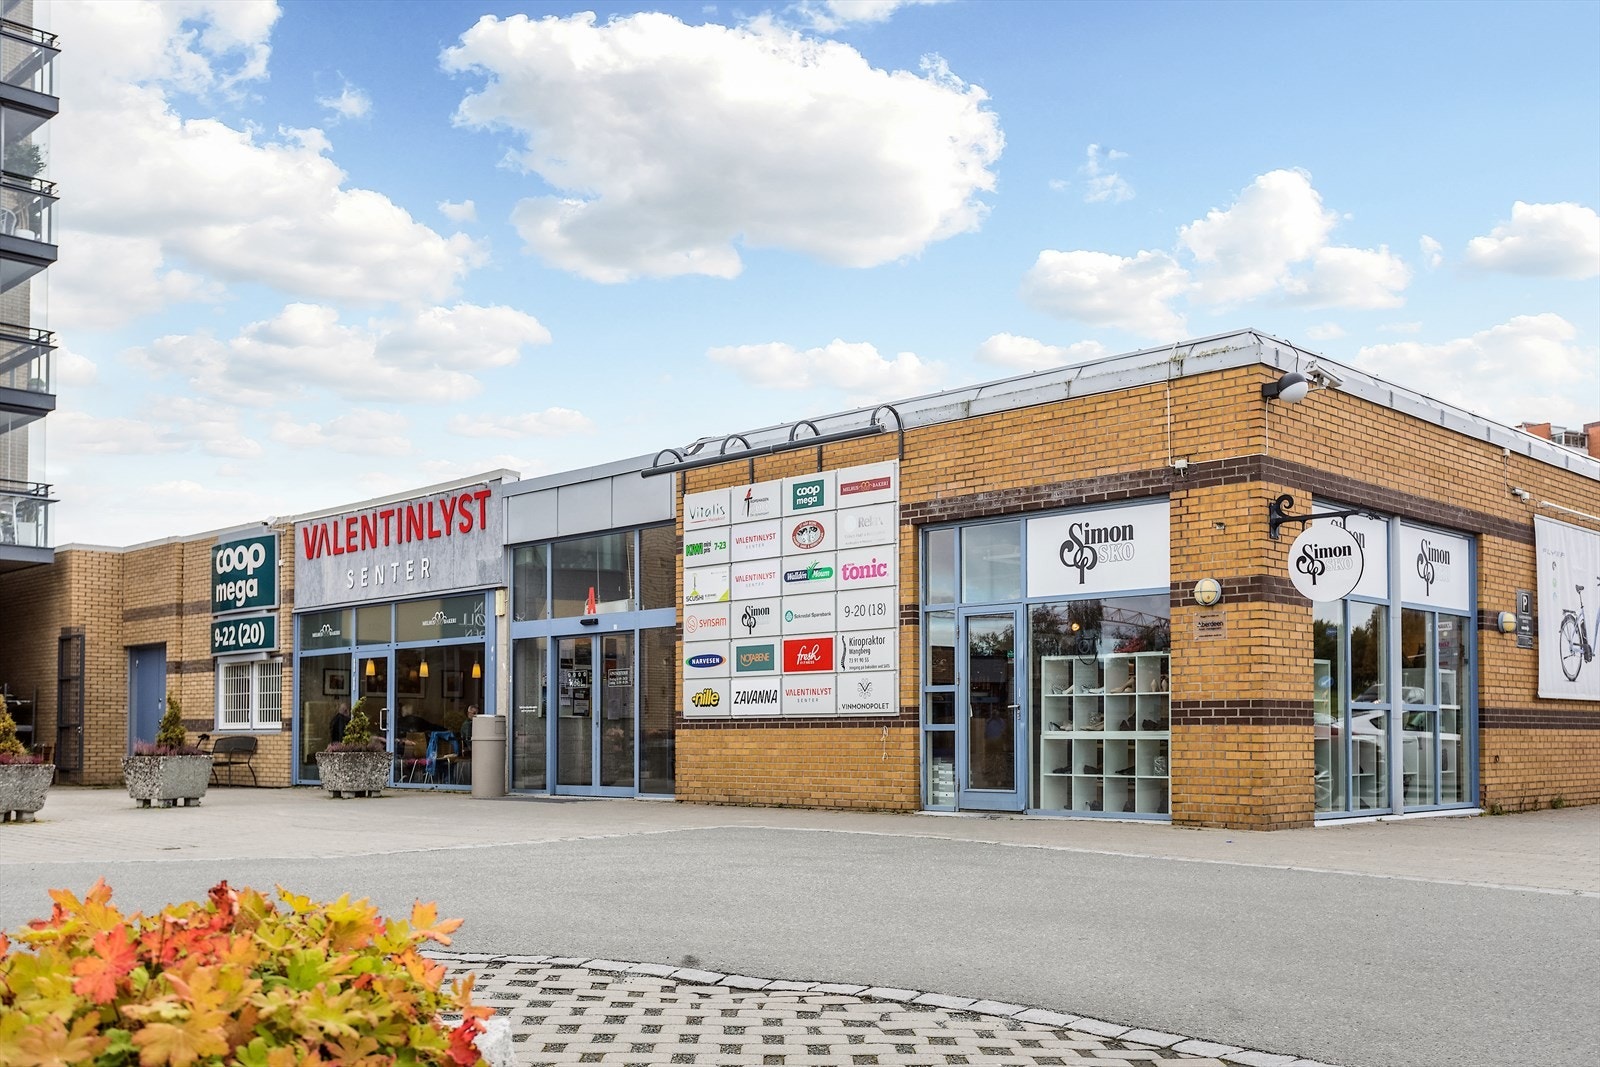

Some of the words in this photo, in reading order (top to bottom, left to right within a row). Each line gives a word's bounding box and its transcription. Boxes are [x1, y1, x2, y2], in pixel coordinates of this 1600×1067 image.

[796, 485, 820, 496] coop
[796, 496, 818, 505] mega
[303, 489, 492, 561] VALENTINLYST
[714, 541, 727, 550] 7-23
[735, 533, 777, 544] VALENTINLYST
[216, 542, 266, 575] coop
[1098, 542, 1135, 563] SKO
[346, 557, 431, 589] SENTER
[842, 558, 888, 581] tonic
[735, 572, 776, 583] VALENTINLYST
[216, 578, 258, 607] mega
[844, 604, 866, 618] 9-20
[868, 602, 887, 616] (18)
[1522, 595, 1528, 611] P
[214, 625, 236, 647] 9-22
[238, 621, 265, 647] (20)
[849, 635, 886, 649] Kiropraktor
[691, 657, 720, 665] NARVESEN
[740, 652, 770, 666] NOTABENE
[796, 644, 821, 665] fresh
[733, 689, 778, 704] ZAVANNA
[785, 688, 832, 696] VALENTINLYST
